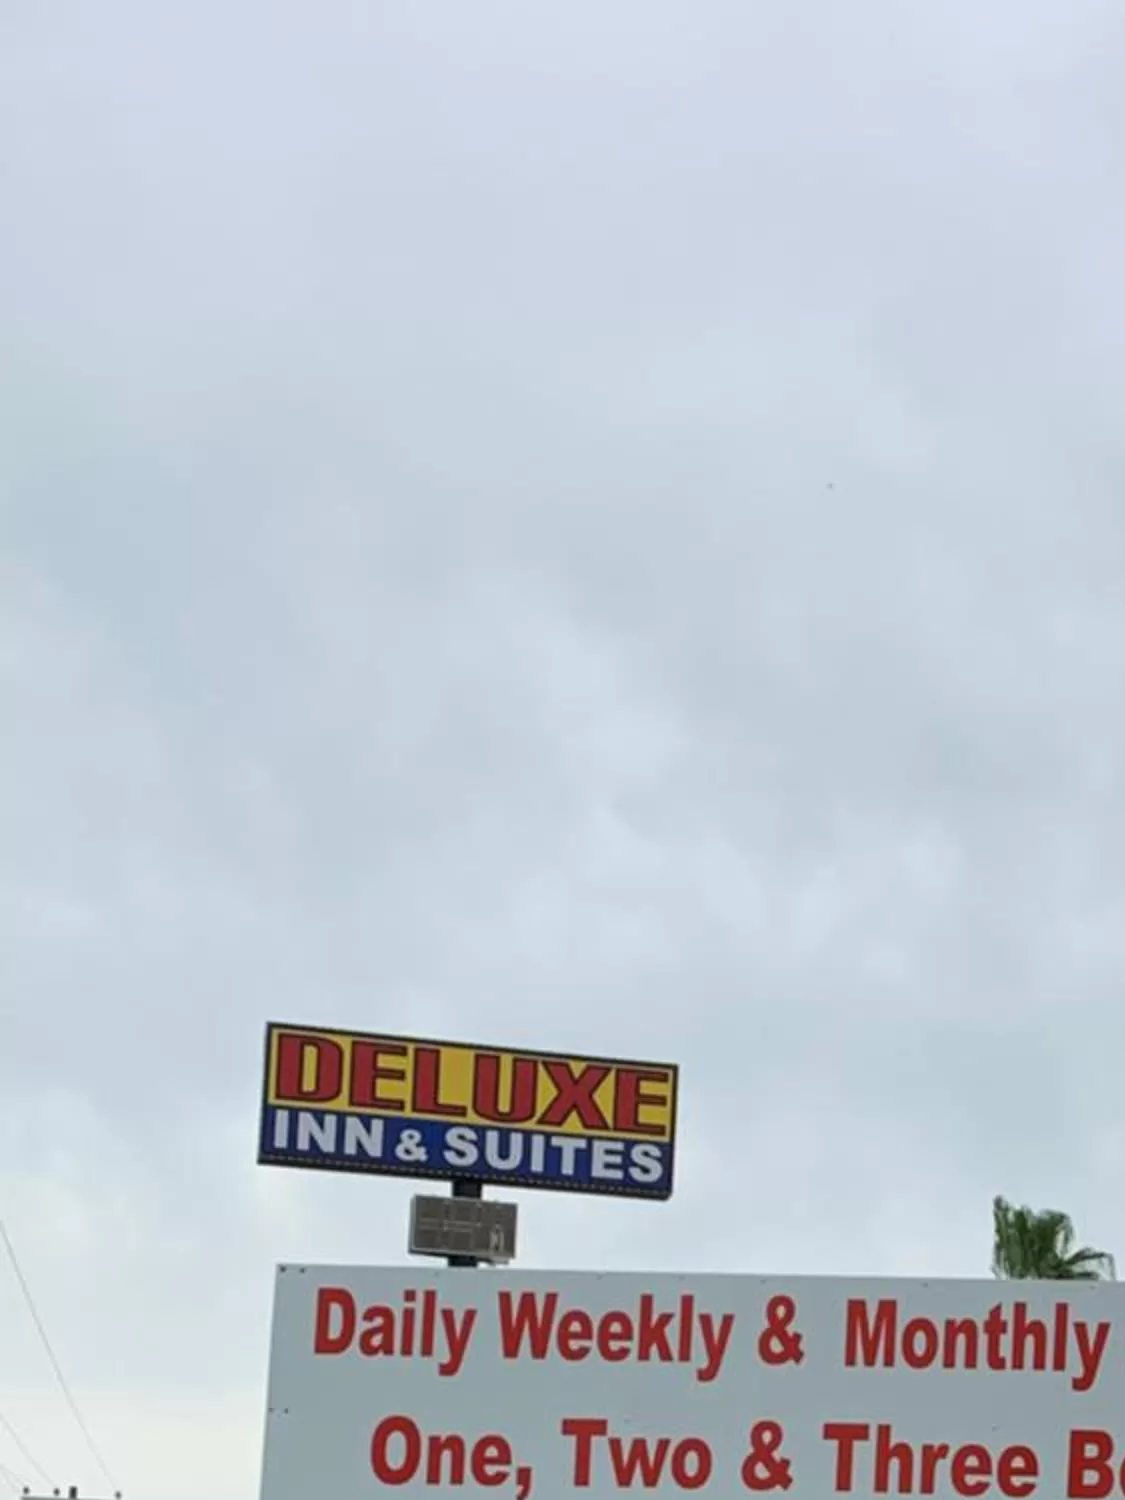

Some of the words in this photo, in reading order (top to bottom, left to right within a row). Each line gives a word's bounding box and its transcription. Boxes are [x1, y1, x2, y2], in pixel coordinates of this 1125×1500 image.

[274, 1032, 669, 1137] DELUXE
[272, 1109, 385, 1158] INN
[395, 1128, 429, 1163] &
[443, 1126, 664, 1184] SUITES
[313, 1287, 477, 1377] Daily
[498, 1291, 735, 1383] Weekly
[758, 1294, 805, 1365] &
[844, 1298, 1111, 1392] Monthly
[561, 1417, 713, 1491] Two
[741, 1420, 794, 1492] &
[823, 1422, 1039, 1499] Three
